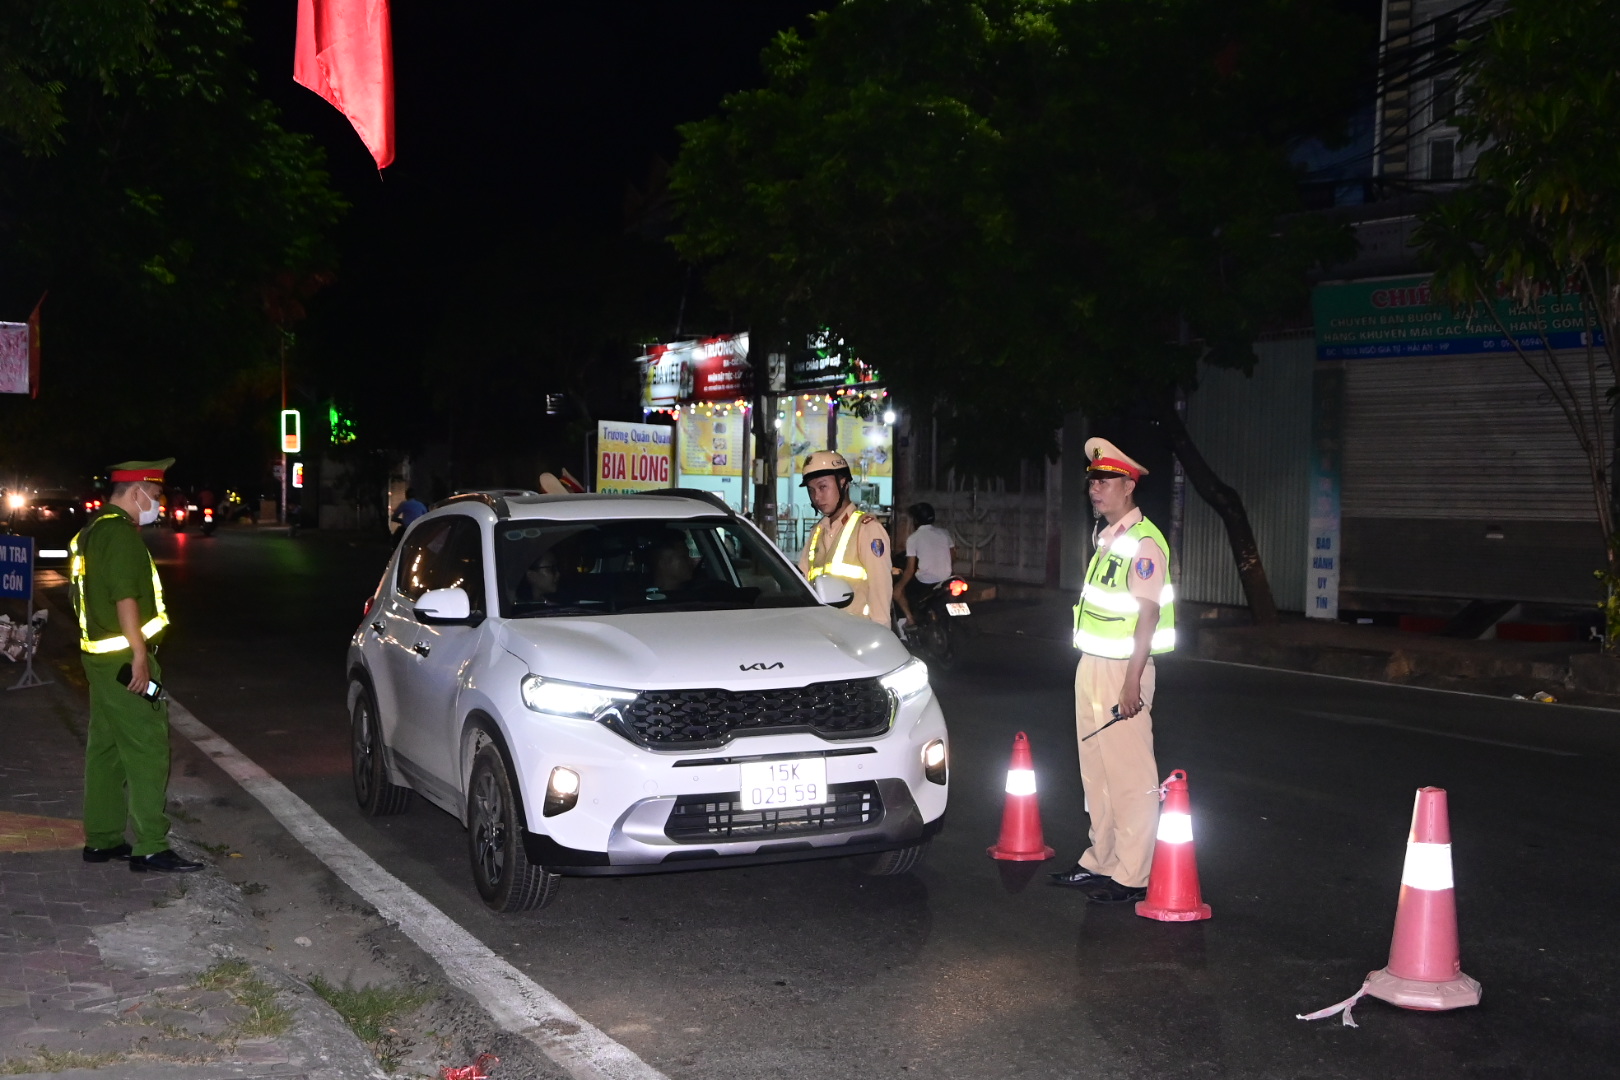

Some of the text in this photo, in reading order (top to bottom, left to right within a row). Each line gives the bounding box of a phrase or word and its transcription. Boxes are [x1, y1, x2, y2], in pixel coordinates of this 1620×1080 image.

[602, 448, 669, 482] BIA LÒNG
[9, 546, 27, 563] TRA
[739, 661, 784, 672] KIA
[769, 763, 800, 782] 15K
